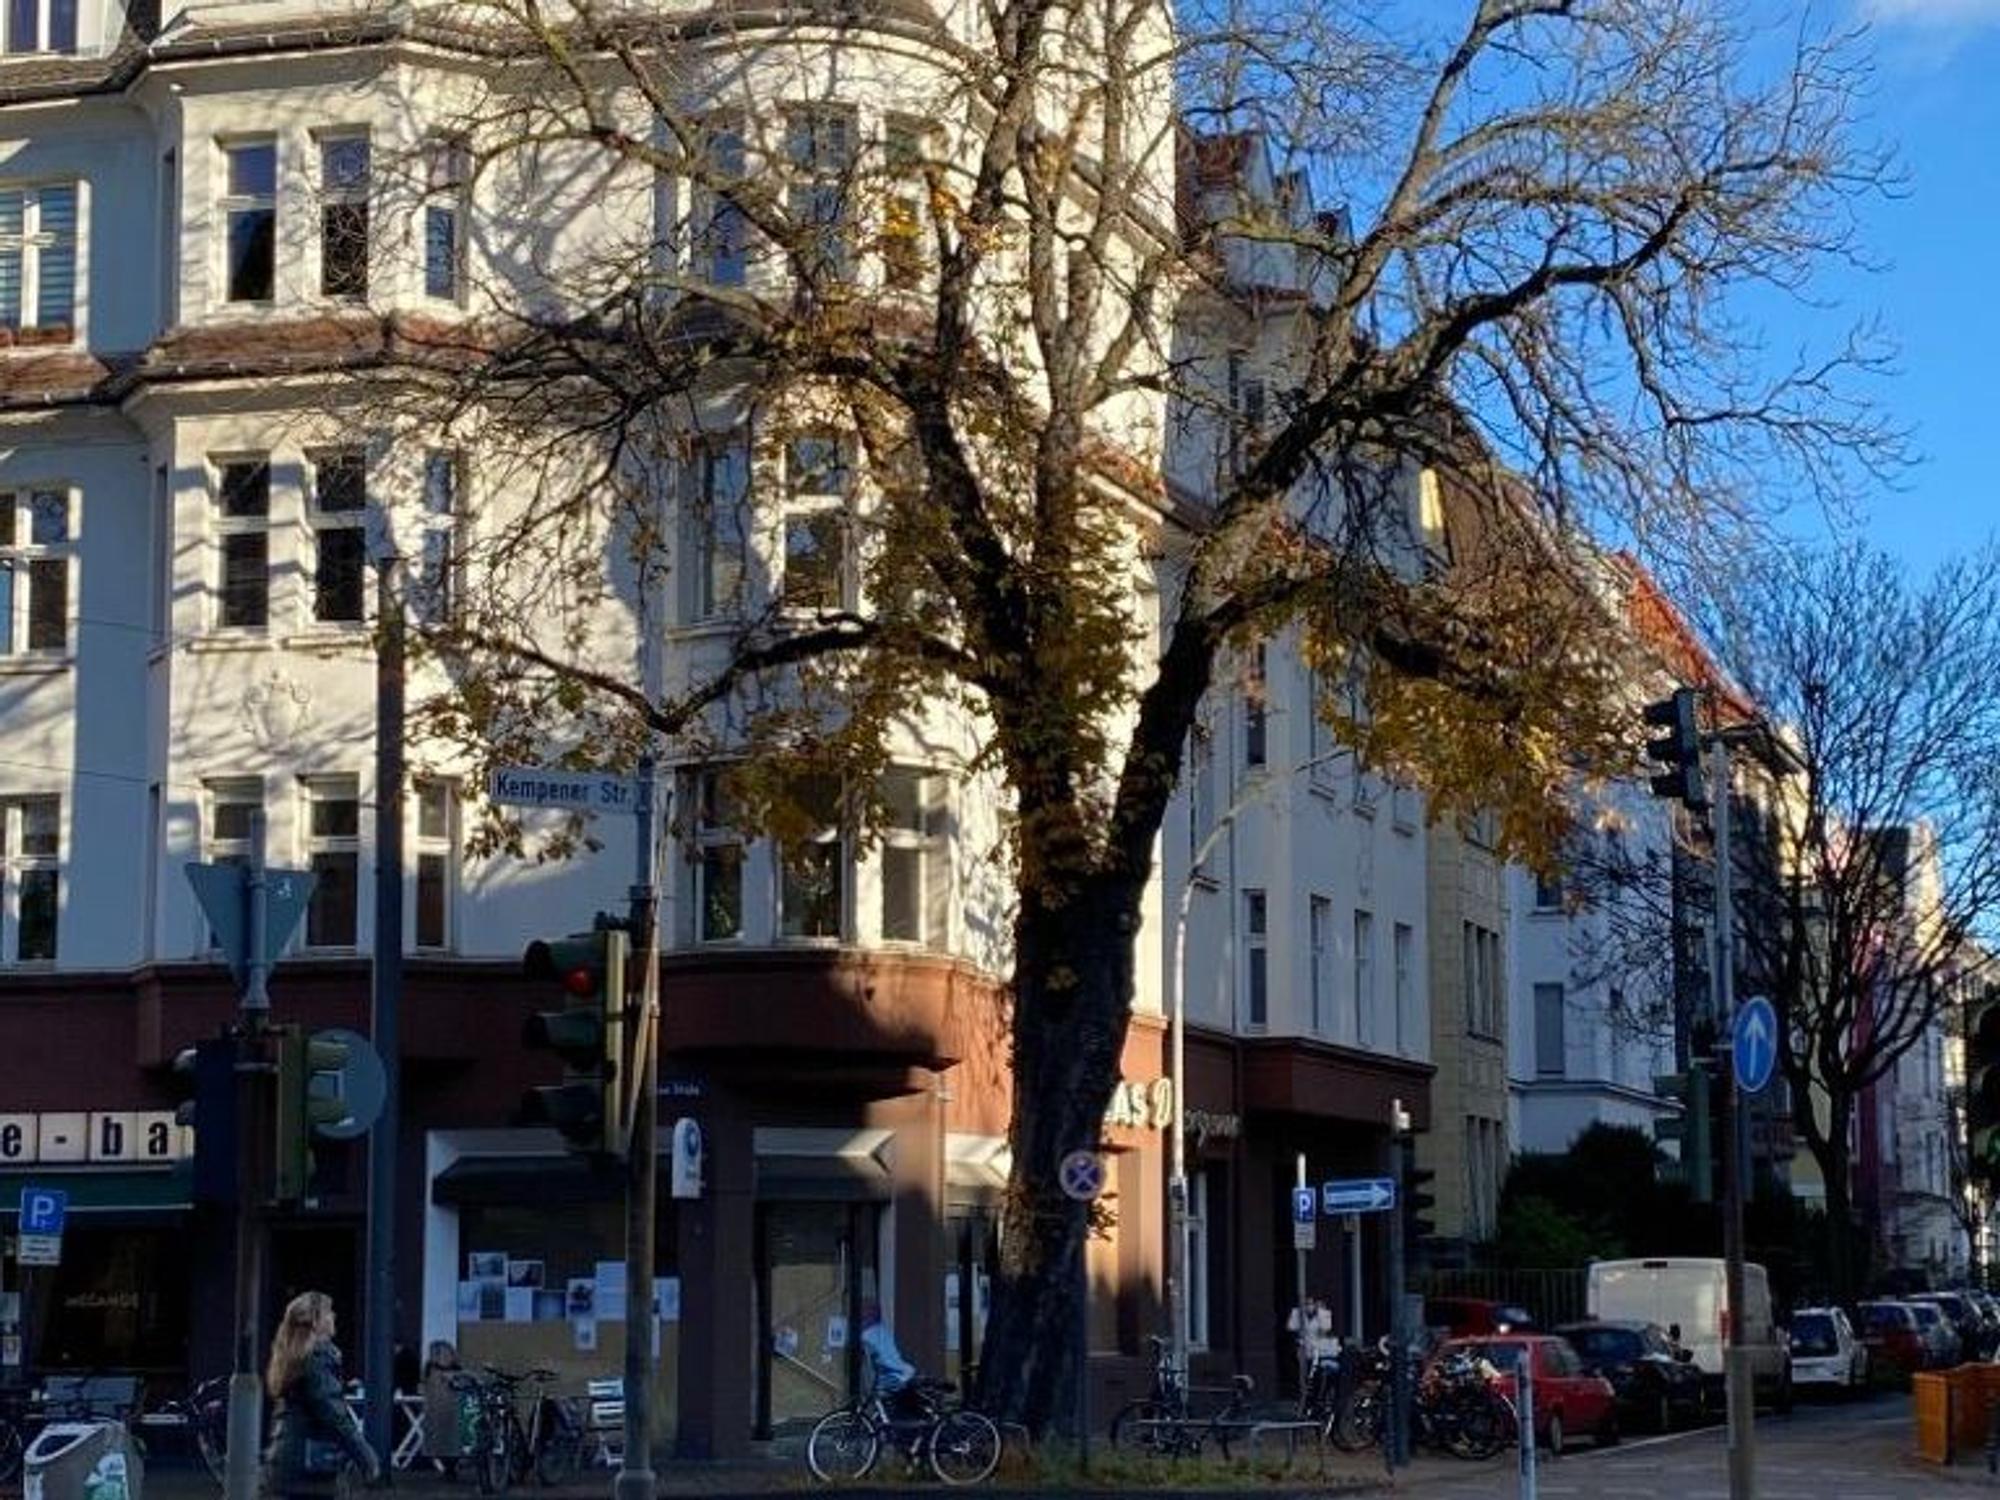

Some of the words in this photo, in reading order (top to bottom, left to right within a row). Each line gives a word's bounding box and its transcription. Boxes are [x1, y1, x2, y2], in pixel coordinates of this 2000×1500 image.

[496, 773, 590, 803] Kempener
[600, 781, 632, 804] Str.
[31, 1194, 55, 1228] P
[1298, 1193, 1311, 1216] P
